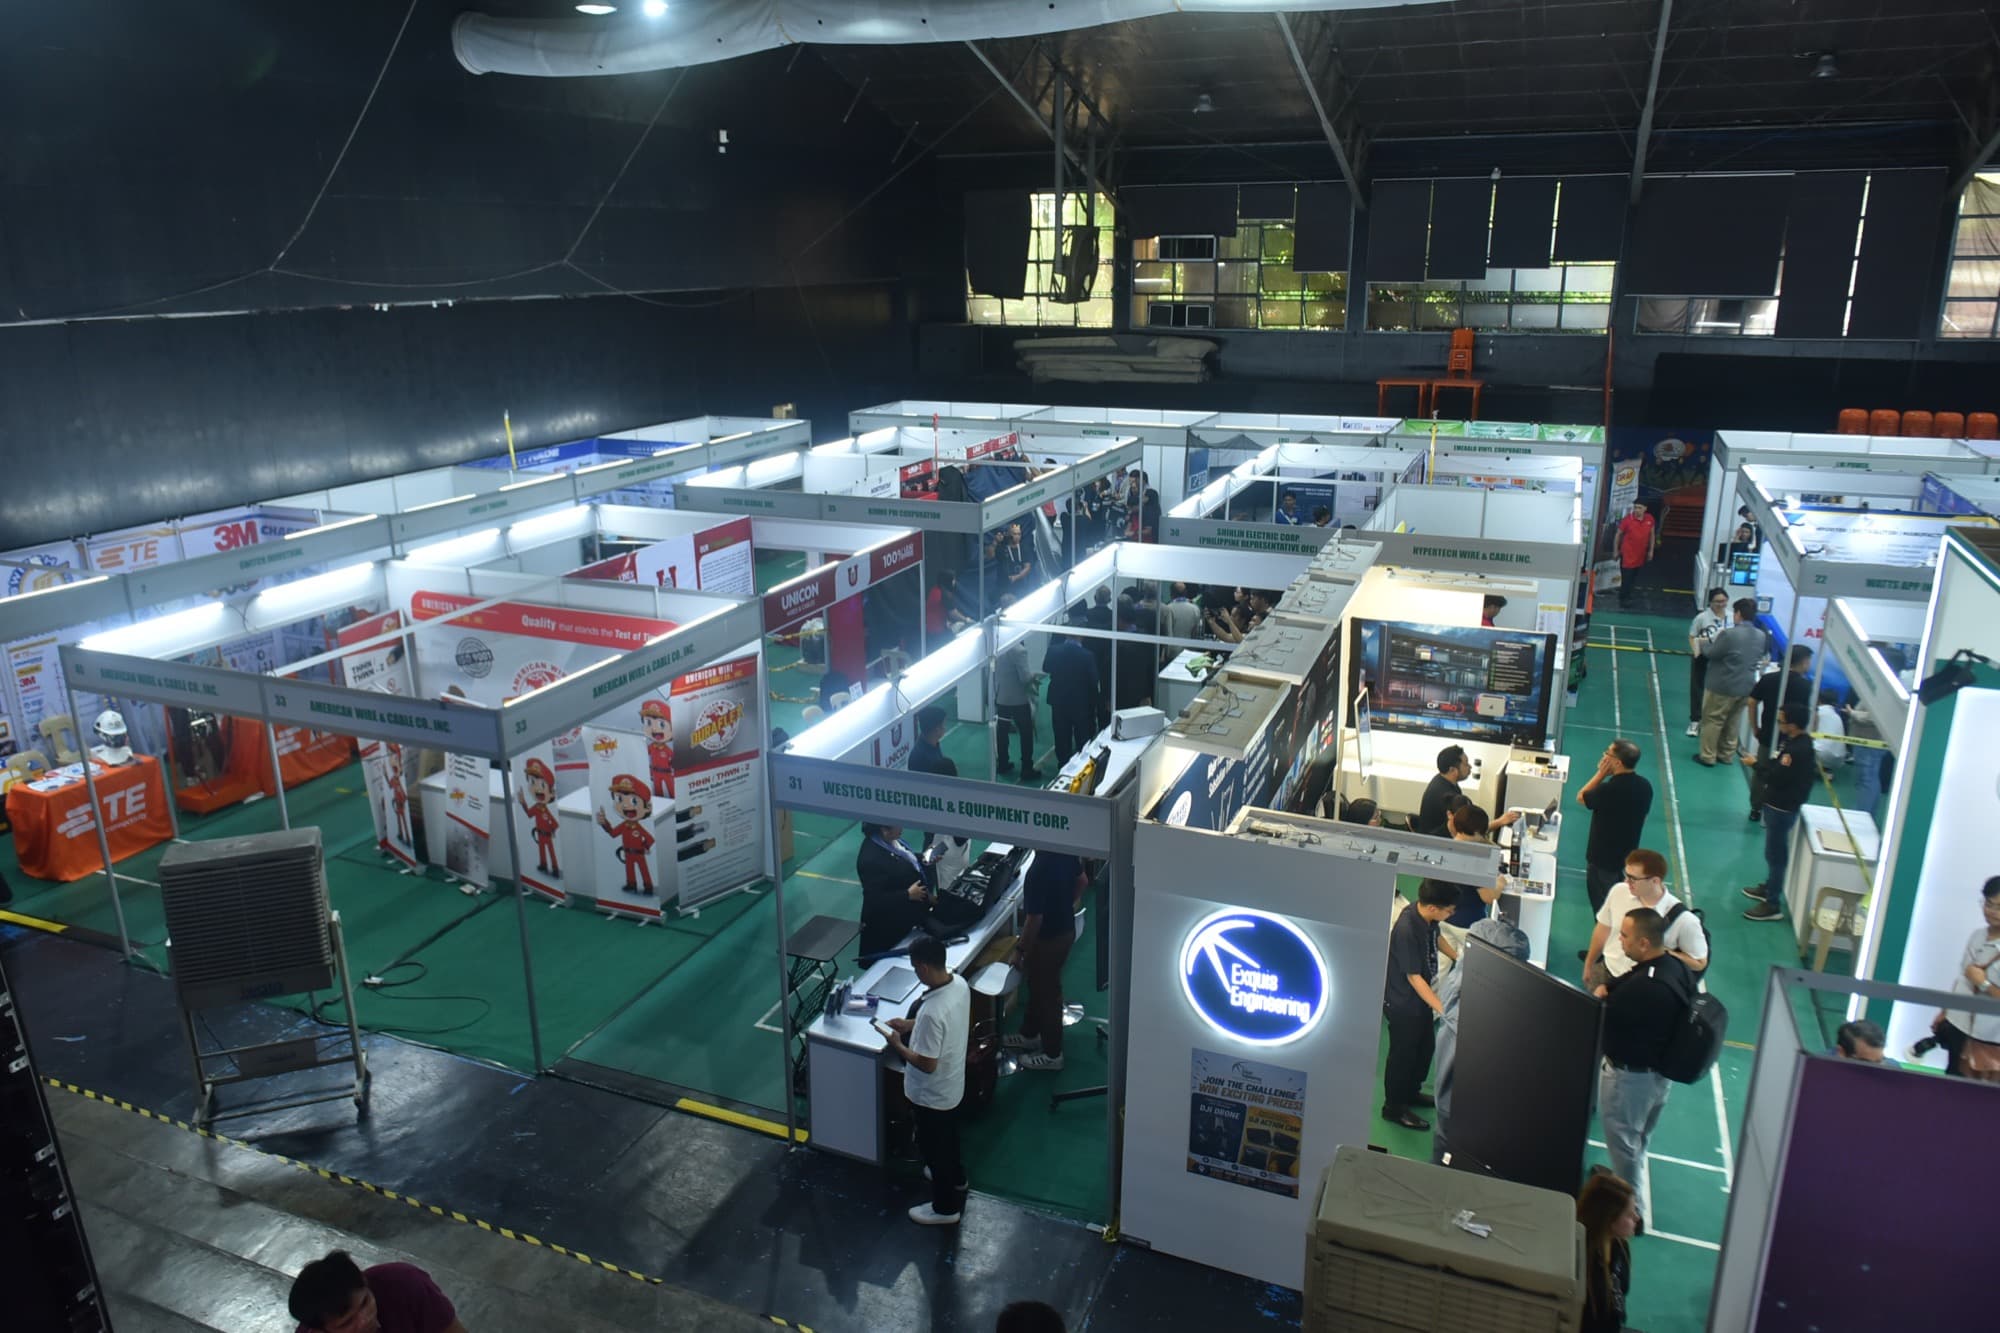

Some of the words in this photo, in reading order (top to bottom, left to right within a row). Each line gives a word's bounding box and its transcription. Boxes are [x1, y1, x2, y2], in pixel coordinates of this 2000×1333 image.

[213, 520, 259, 552] 3M
[1241, 540, 1300, 552] REPRESENTATIVE
[1246, 530, 1278, 541] ELECTRIC
[129, 539, 160, 563] TE
[1412, 546, 1458, 559] HYPERTECH
[1459, 549, 1480, 560] WIRE
[1481, 552, 1488, 560] &
[1489, 551, 1513, 563] CABLE
[1814, 574, 1827, 584] 22
[781, 581, 820, 610] UNICON
[521, 614, 557, 632] Quality
[615, 629, 630, 641] Test
[633, 631, 641, 641] of
[1804, 628, 1825, 639] AB
[512, 661, 548, 692] AMERICAN
[685, 668, 717, 685] AMERICAN
[515, 719, 528, 735] 33
[593, 673, 628, 698] AMERICAN
[628, 665, 645, 682] WIRE
[652, 655, 671, 671] CABLE
[309, 700, 353, 718] AMERICAN
[354, 706, 378, 722] WIRE
[379, 714, 386, 723] &
[387, 711, 414, 728] CABLE
[691, 699, 745, 748] DURAFLEX
[716, 767, 740, 781] THWN
[104, 781, 147, 821] TE
[789, 775, 802, 790] 31
[823, 780, 872, 801] WESTCO
[875, 788, 944, 812] ELECTRICAL
[947, 801, 956, 813] &
[958, 801, 1031, 825] EQUIPMENT
[1033, 813, 1070, 831] CORP.
[1231, 963, 1278, 992] Exquis
[1230, 985, 1310, 1024] Engineering
[1199, 1083, 1218, 1096] WIN
[1220, 1087, 1265, 1104] EXCITING
[1203, 1075, 1225, 1087] JOIN
[1227, 1079, 1243, 1090] THE
[1246, 1082, 1298, 1100] CHALLENGE
[1199, 1103, 1212, 1113] DJI
[1214, 1107, 1241, 1120] DRONE
